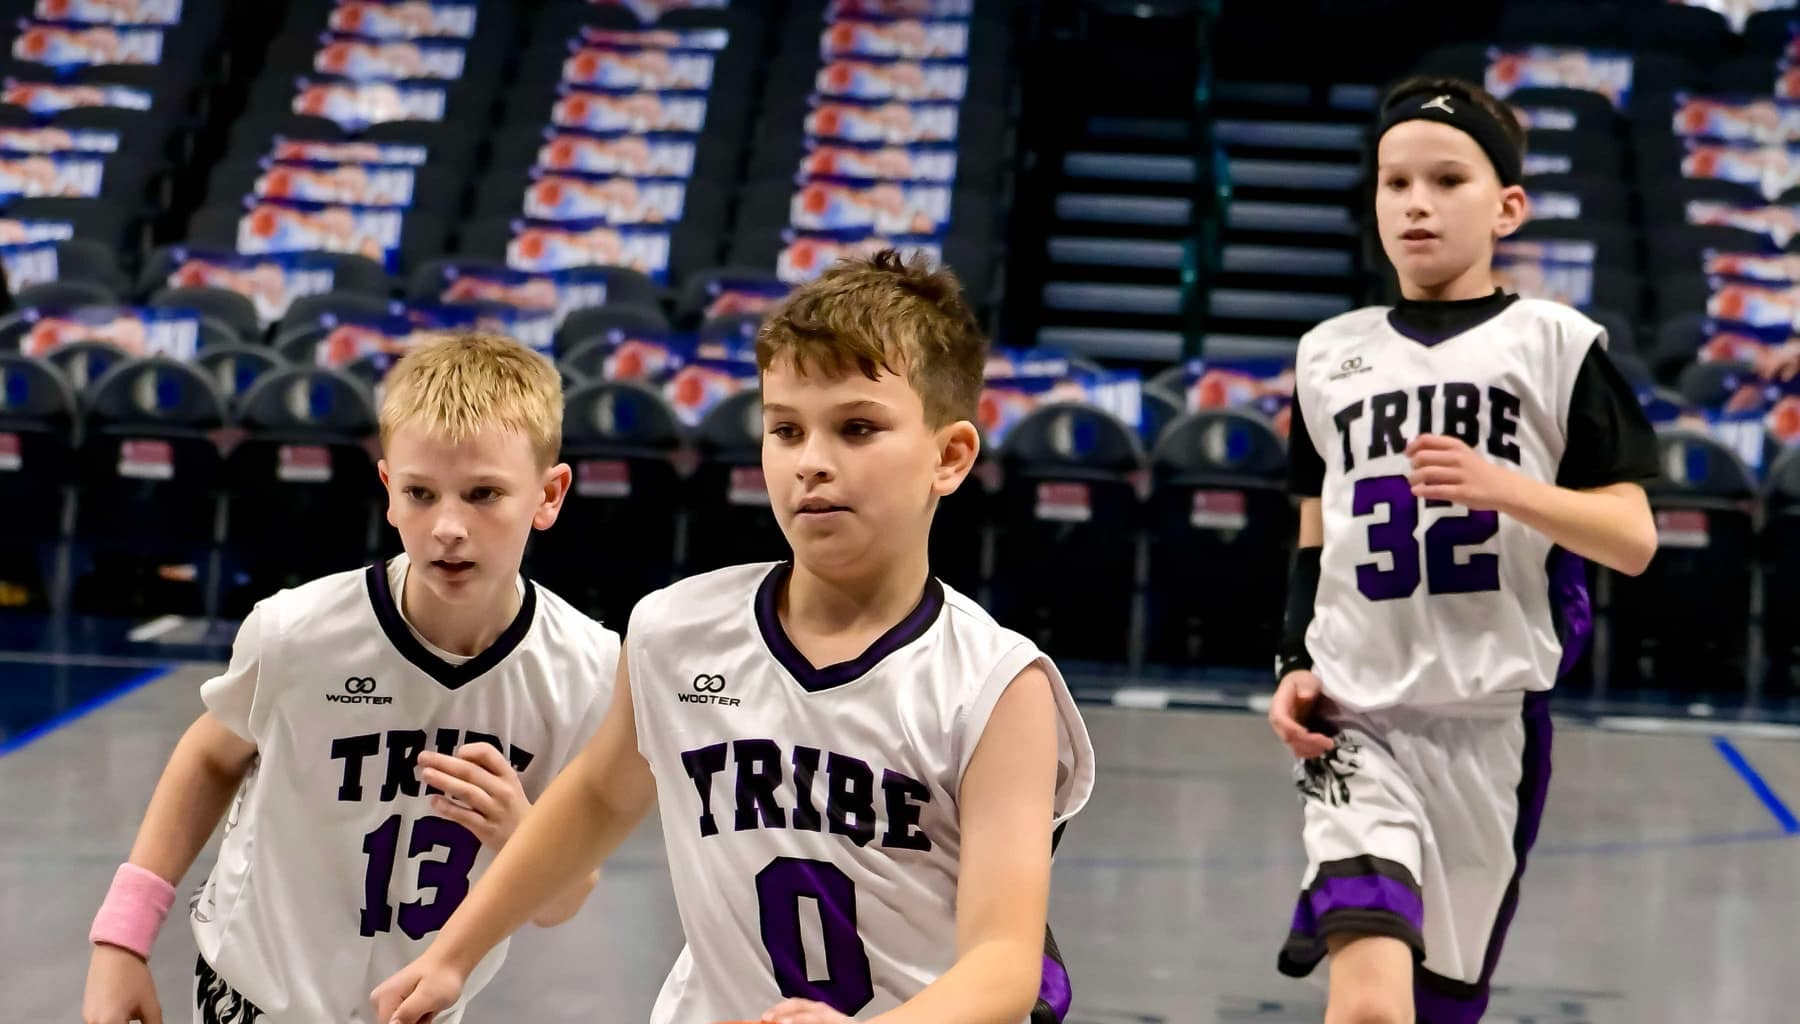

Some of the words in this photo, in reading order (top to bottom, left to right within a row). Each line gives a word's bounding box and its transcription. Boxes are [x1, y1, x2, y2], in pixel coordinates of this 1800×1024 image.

[1333, 382, 1521, 475] TRIBE
[1352, 475, 1500, 601] 32
[326, 693, 393, 705] WOOTER
[678, 692, 741, 707] WOOTER
[331, 728, 534, 802] TRI
[681, 739, 932, 852] TRIBE
[360, 814, 482, 941] 13
[755, 856, 875, 1018] 0
